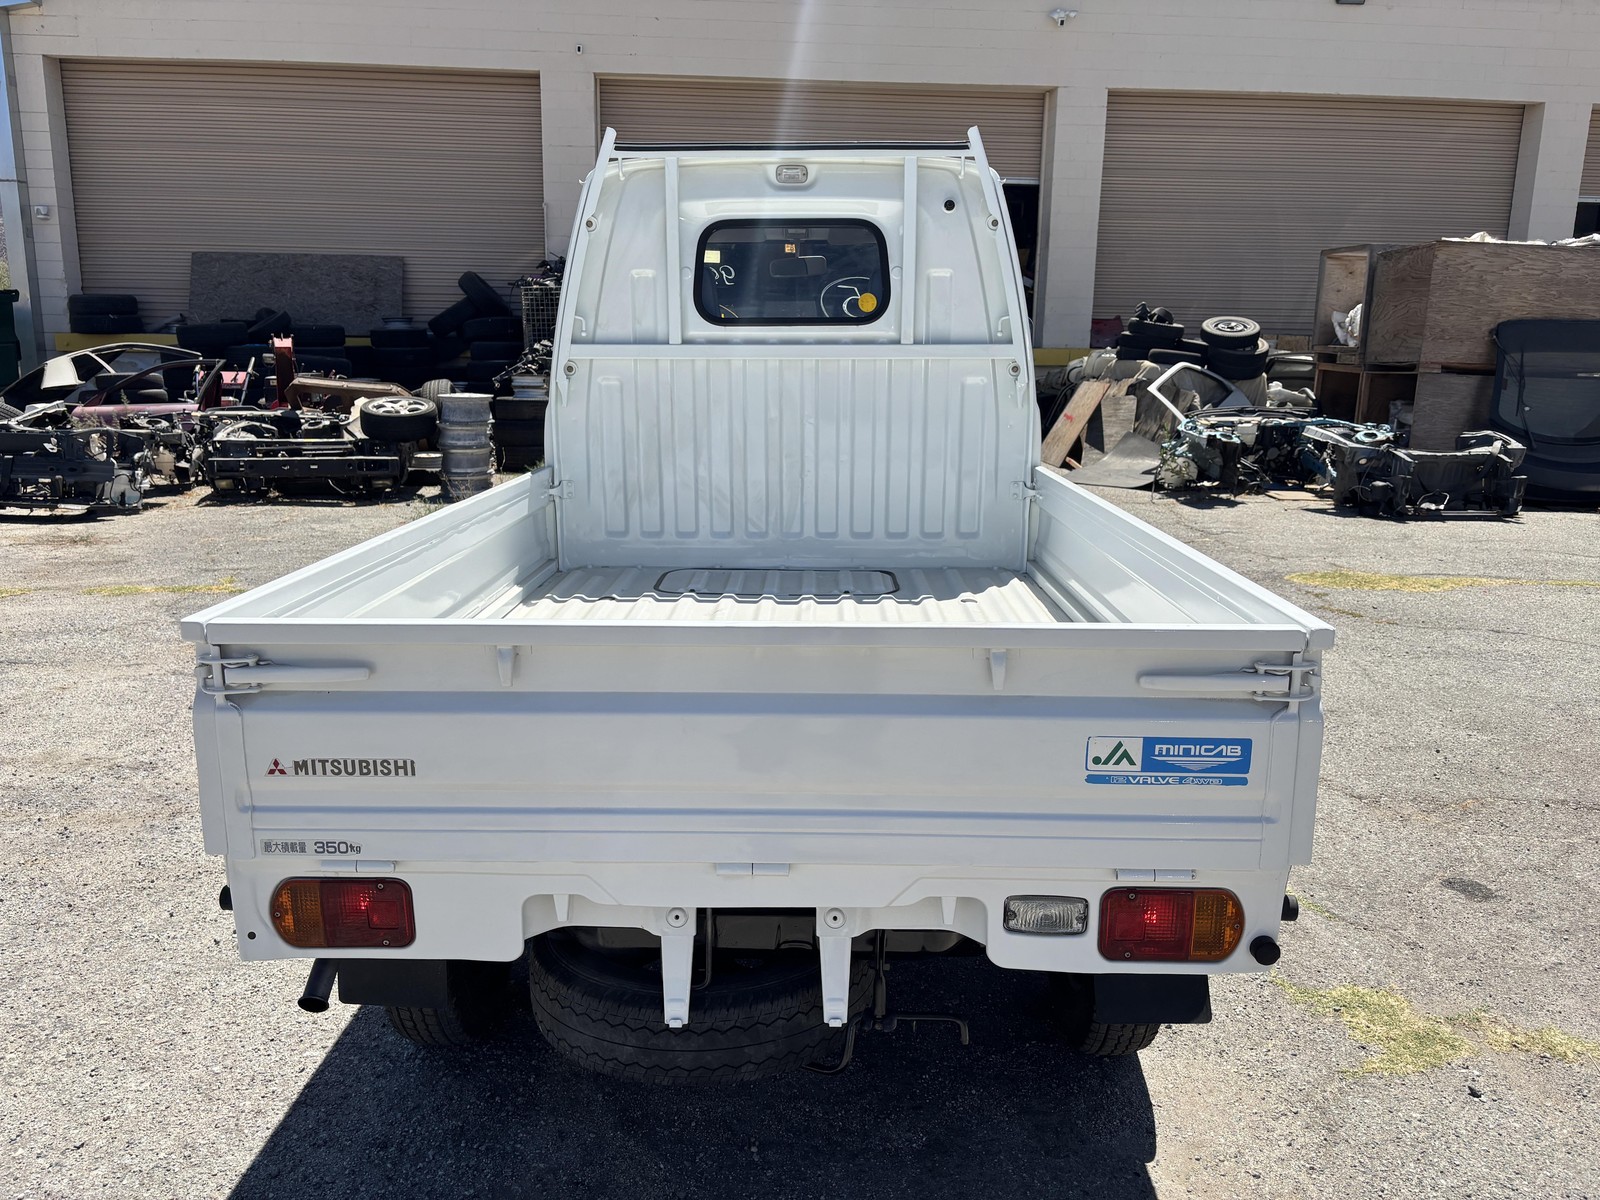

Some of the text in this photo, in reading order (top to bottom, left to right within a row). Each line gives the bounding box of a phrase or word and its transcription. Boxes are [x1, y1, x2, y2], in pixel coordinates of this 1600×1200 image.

[1154, 744, 1242, 756] MINICAB
[293, 758, 416, 777] MITSUBISHI
[1128, 776, 1180, 785] VALVE
